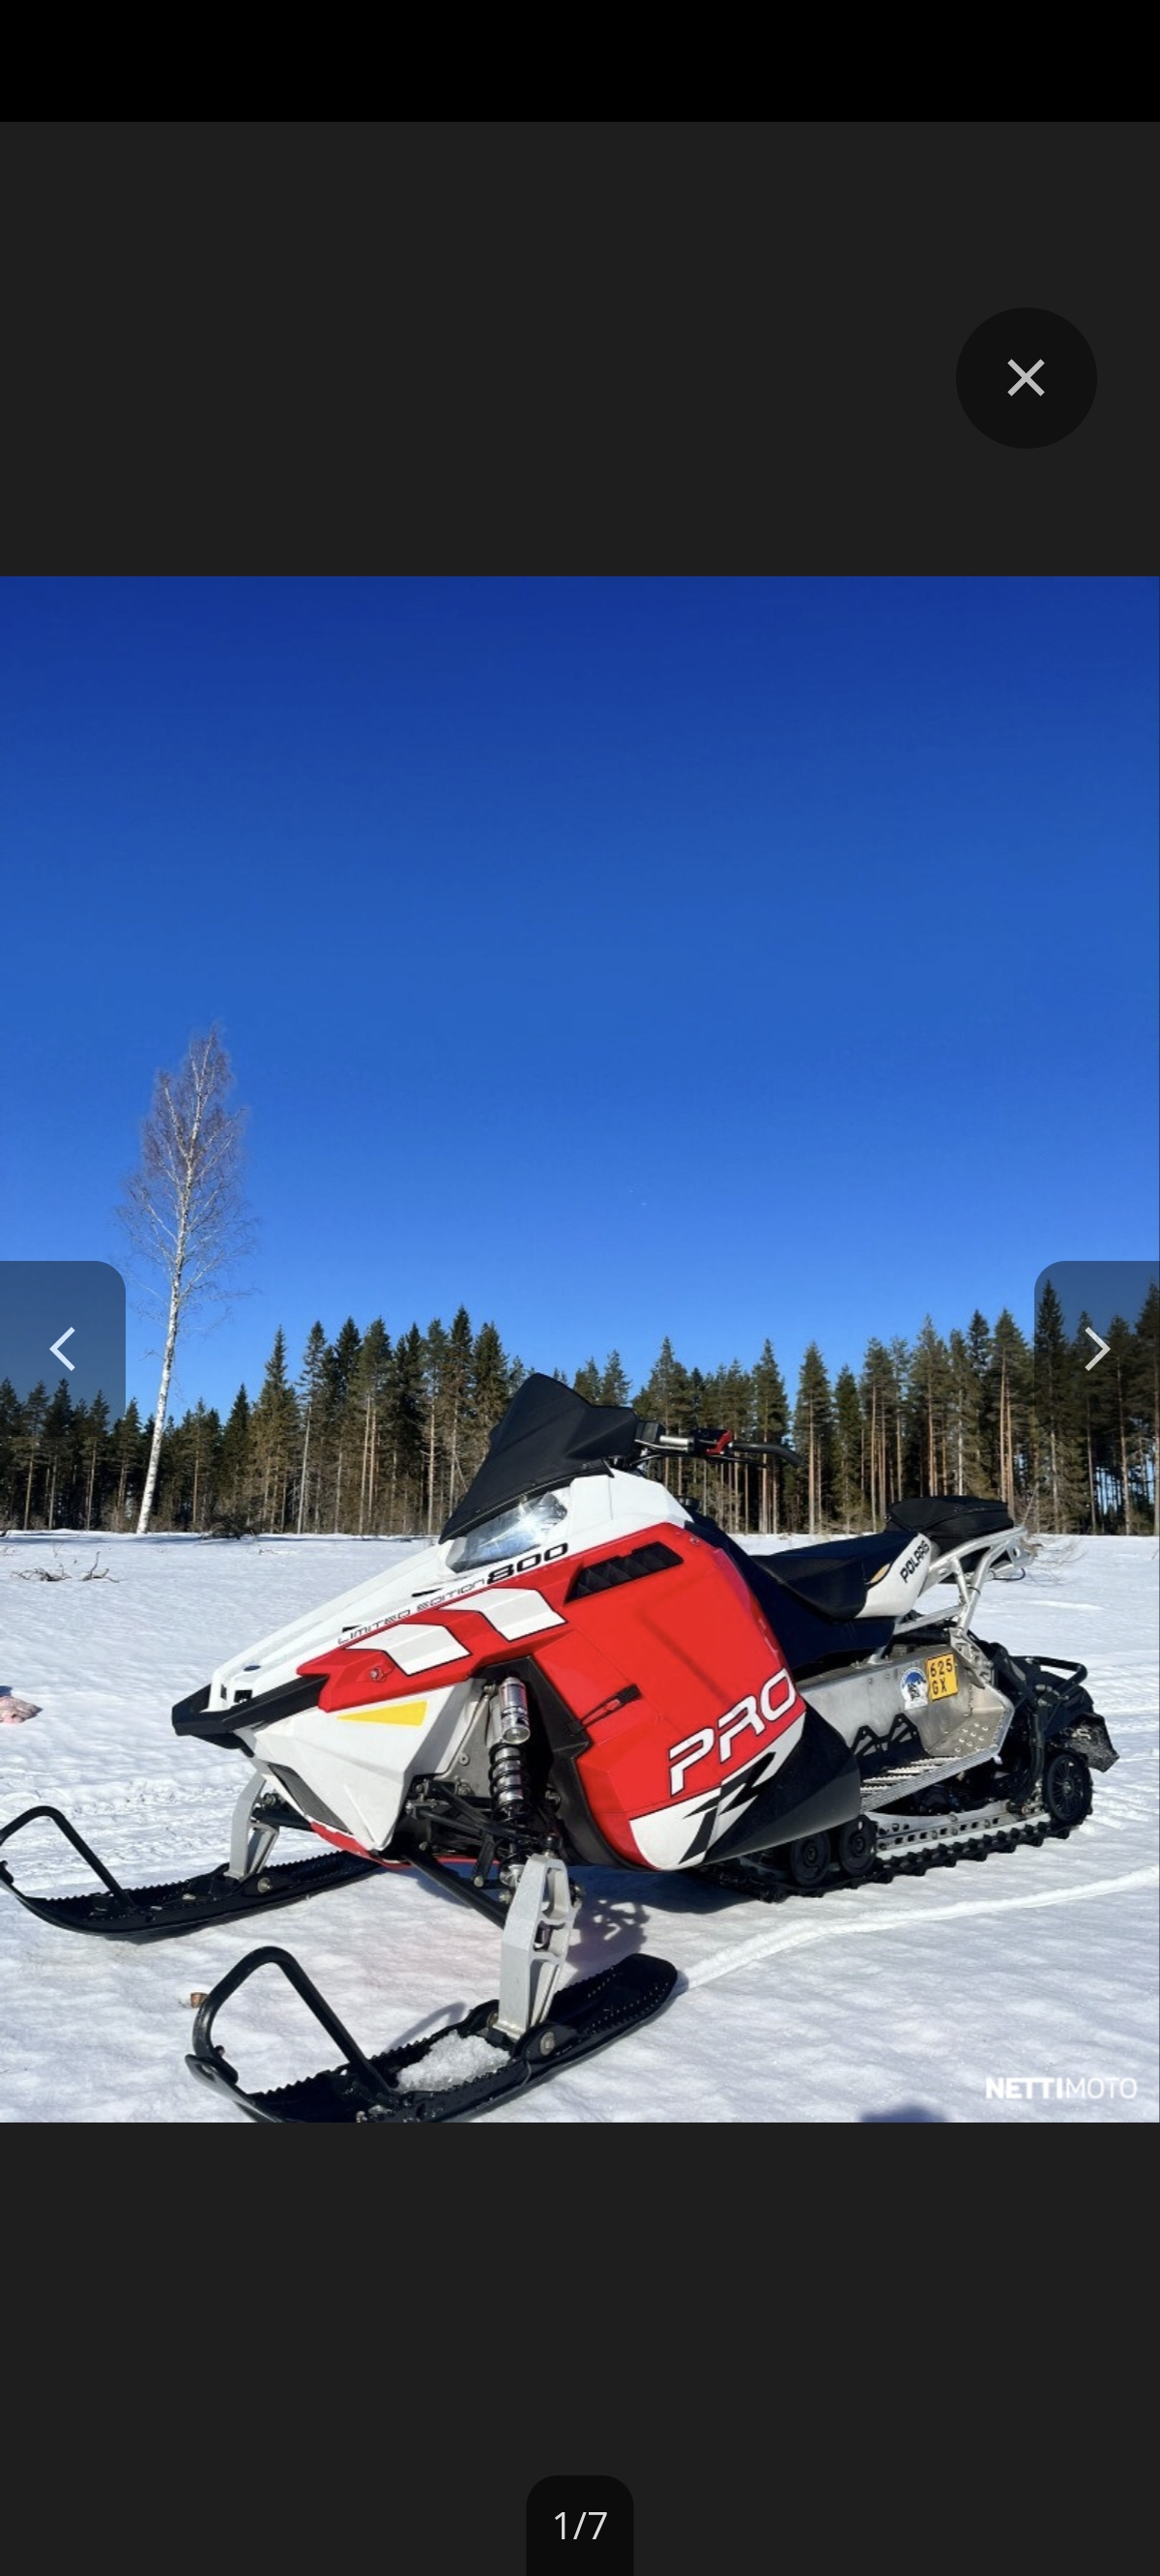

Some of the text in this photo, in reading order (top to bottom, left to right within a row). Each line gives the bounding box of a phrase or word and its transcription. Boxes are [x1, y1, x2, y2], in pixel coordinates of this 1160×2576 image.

[900, 1539, 930, 1583] POLARIS
[338, 1542, 568, 1645] LIMITED EDITION 800
[930, 1657, 953, 1678] 625
[932, 1677, 947, 1695] GX
[668, 1667, 797, 1798] PRO
